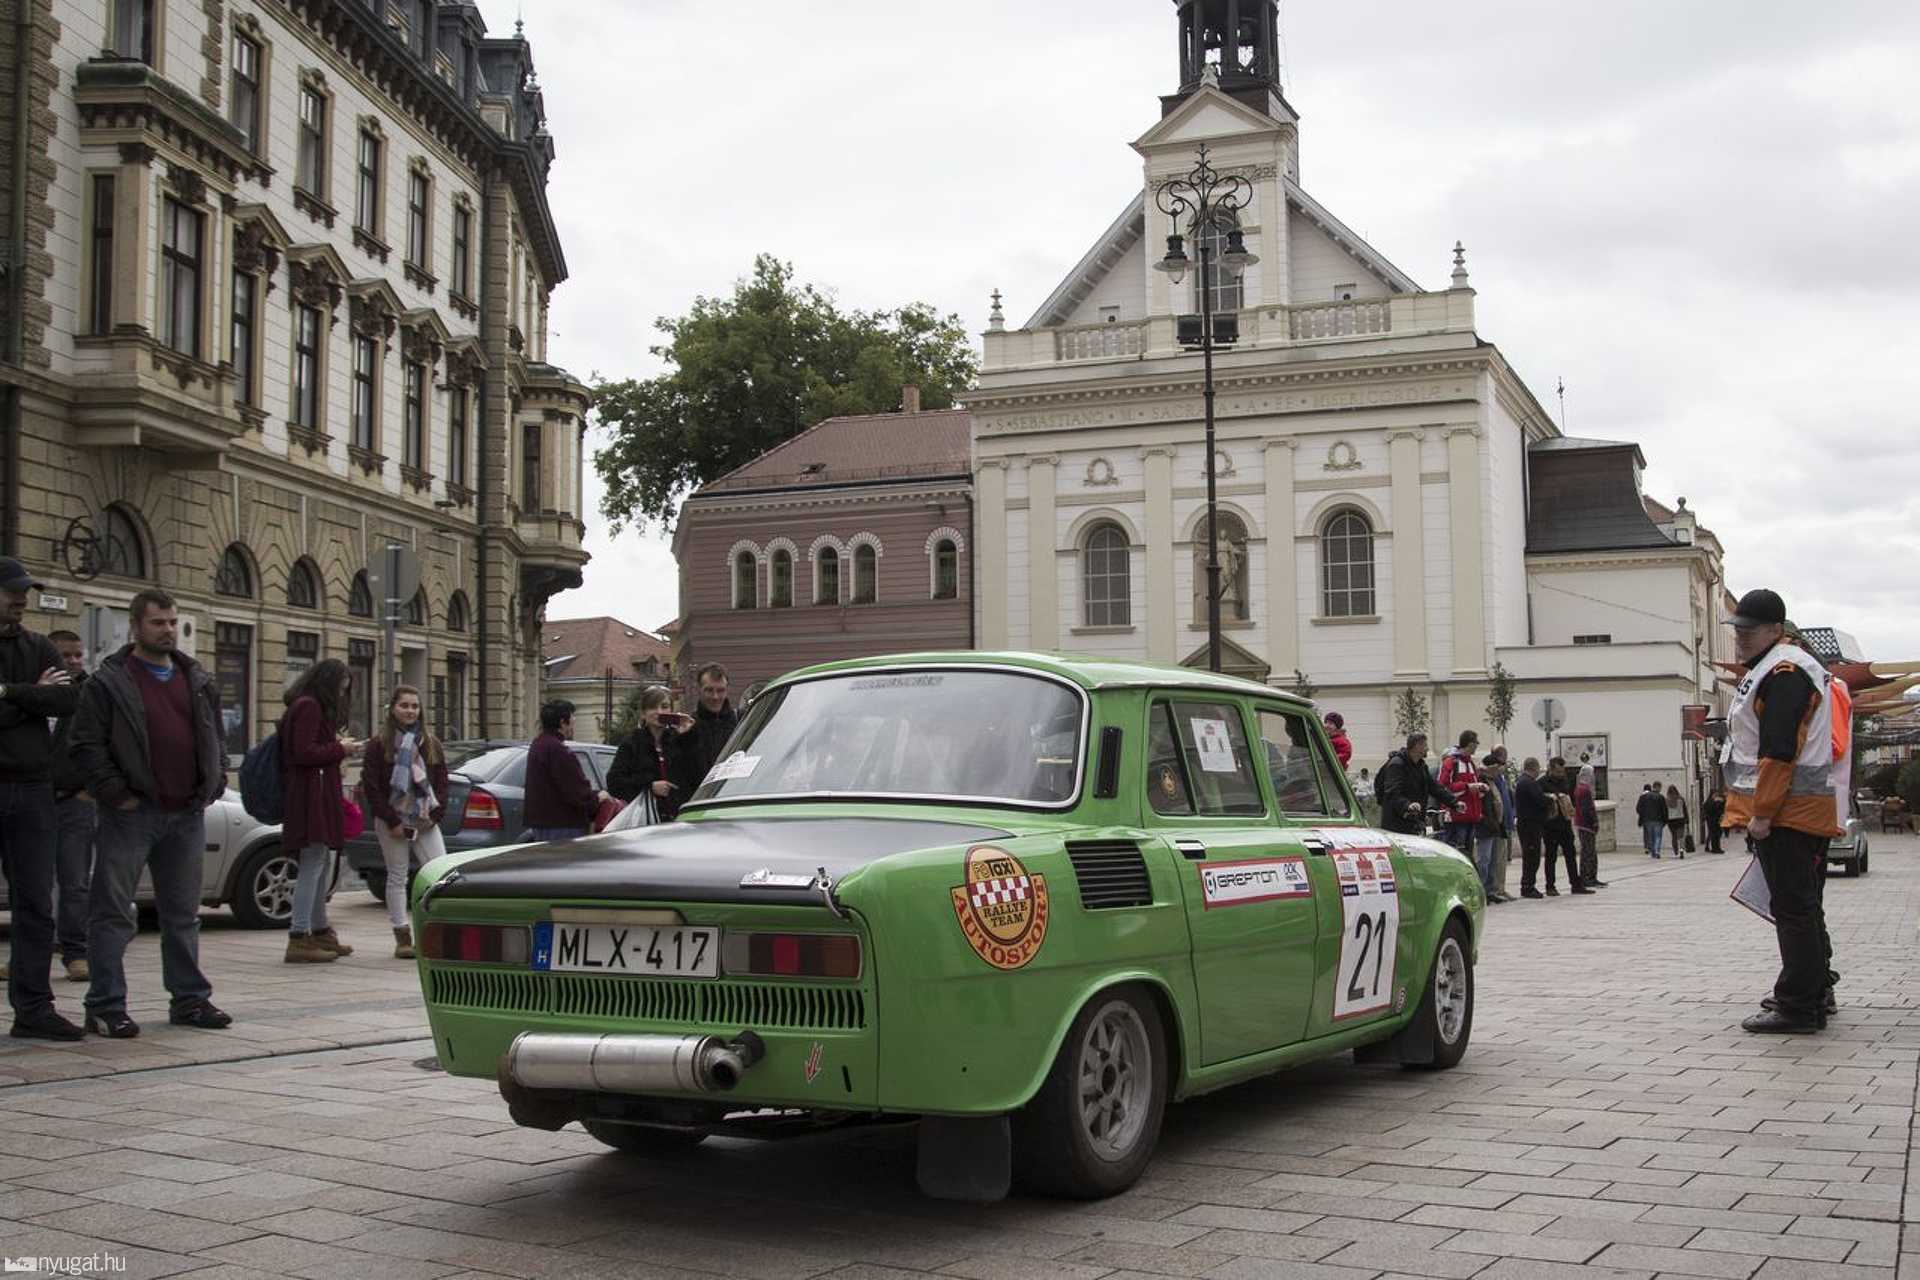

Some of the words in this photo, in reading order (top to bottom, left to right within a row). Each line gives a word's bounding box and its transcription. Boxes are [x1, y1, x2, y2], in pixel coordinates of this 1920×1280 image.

[1217, 870, 1280, 888] GREPTON
[953, 877, 1046, 965] AUTOSPORT
[983, 901, 1028, 918] RALLYE
[991, 912, 1025, 928] TEAM
[537, 951, 547, 964] H
[558, 928, 710, 971] MLX-417
[1347, 911, 1386, 1002] 21
